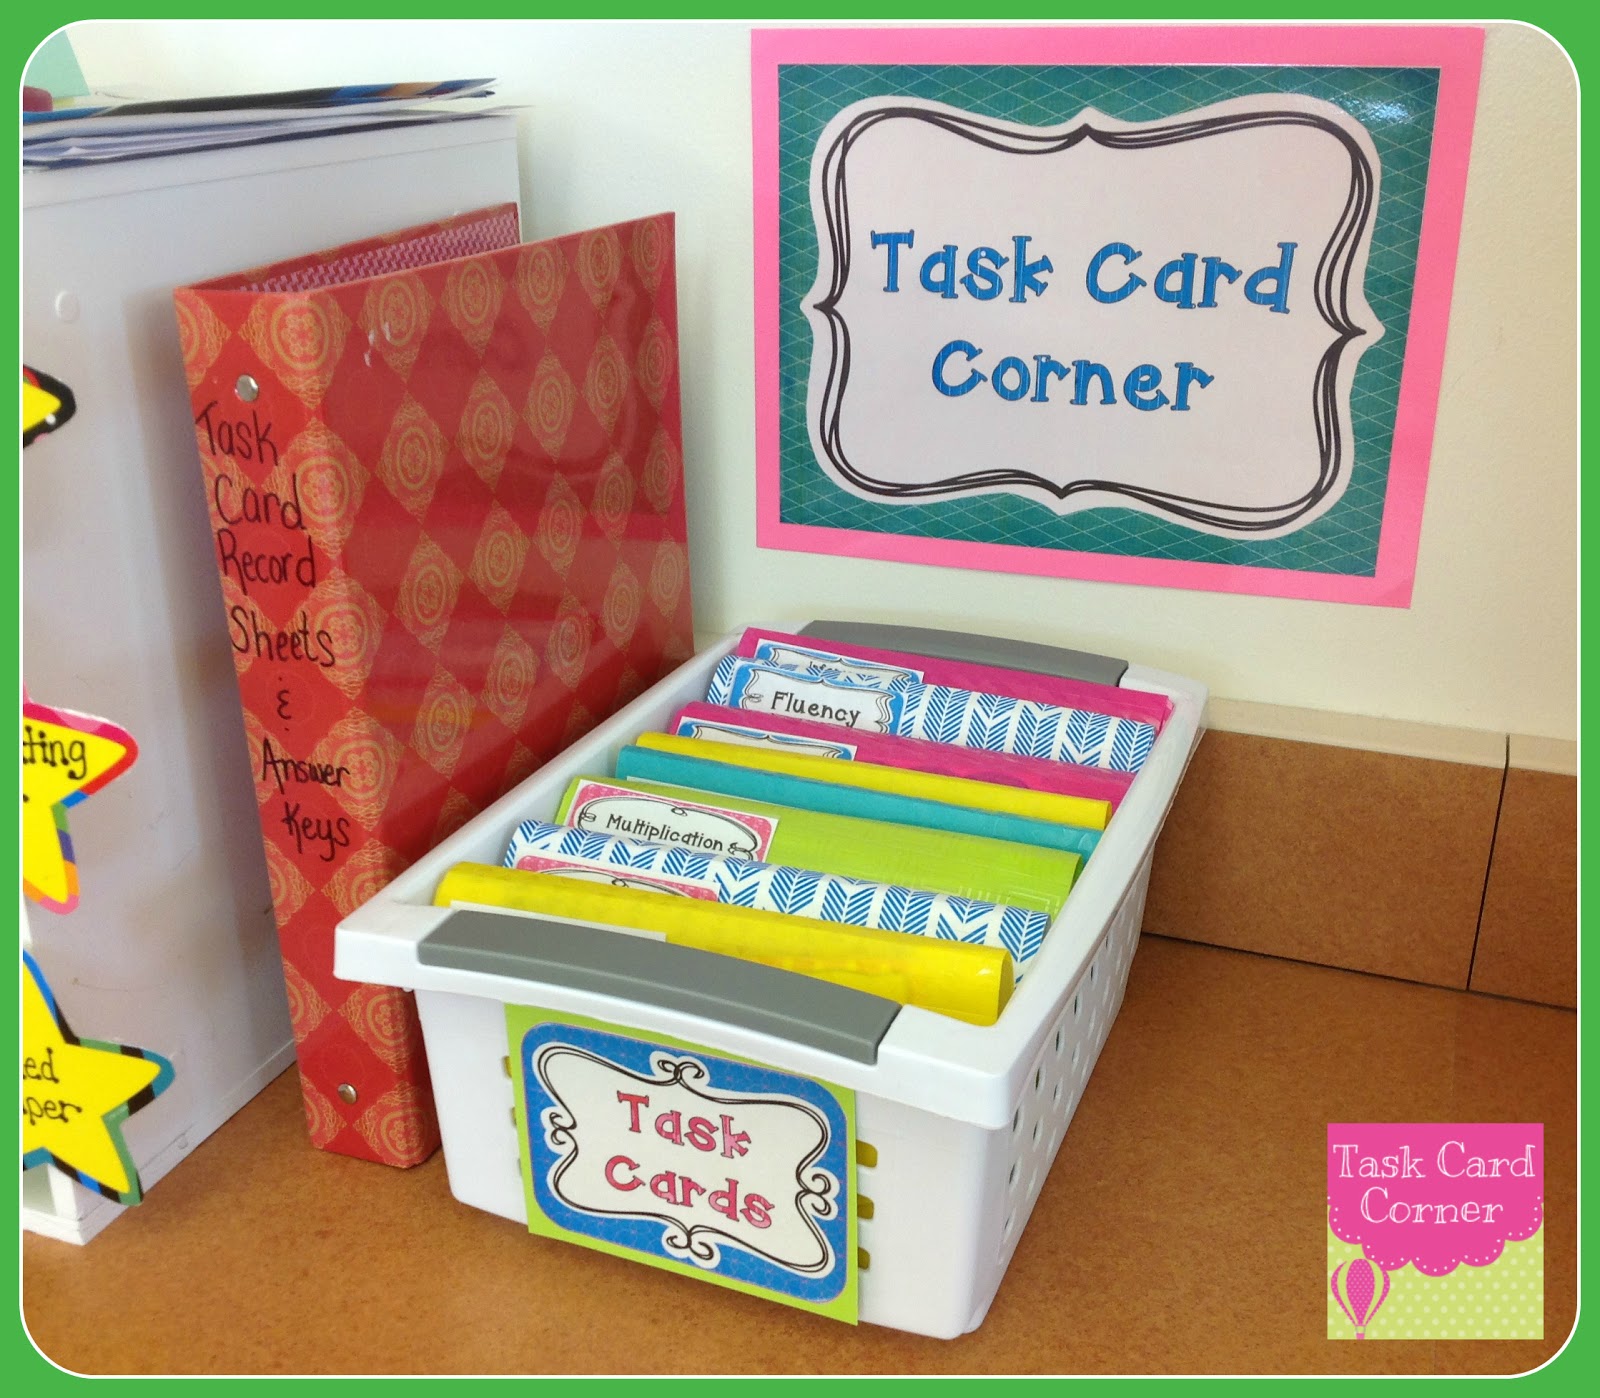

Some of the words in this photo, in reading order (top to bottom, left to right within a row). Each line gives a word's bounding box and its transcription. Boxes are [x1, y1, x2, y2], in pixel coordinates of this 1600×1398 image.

[870, 229, 1054, 303] Task
[1085, 241, 1298, 314] Card
[931, 339, 1215, 412] Corner
[195, 401, 279, 466] Task
[214, 473, 306, 531] Card
[216, 528, 317, 596] Record
[230, 604, 336, 668] Sheets
[770, 690, 862, 728] Fluency
[22, 725, 88, 780] ting
[261, 737, 351, 794] Answer
[283, 800, 352, 862] Keys
[606, 813, 724, 852] Multiplication
[22, 1046, 60, 1084] ed
[22, 1096, 83, 1127] per
[616, 1090, 752, 1159] Task
[604, 1154, 776, 1230] Cards
